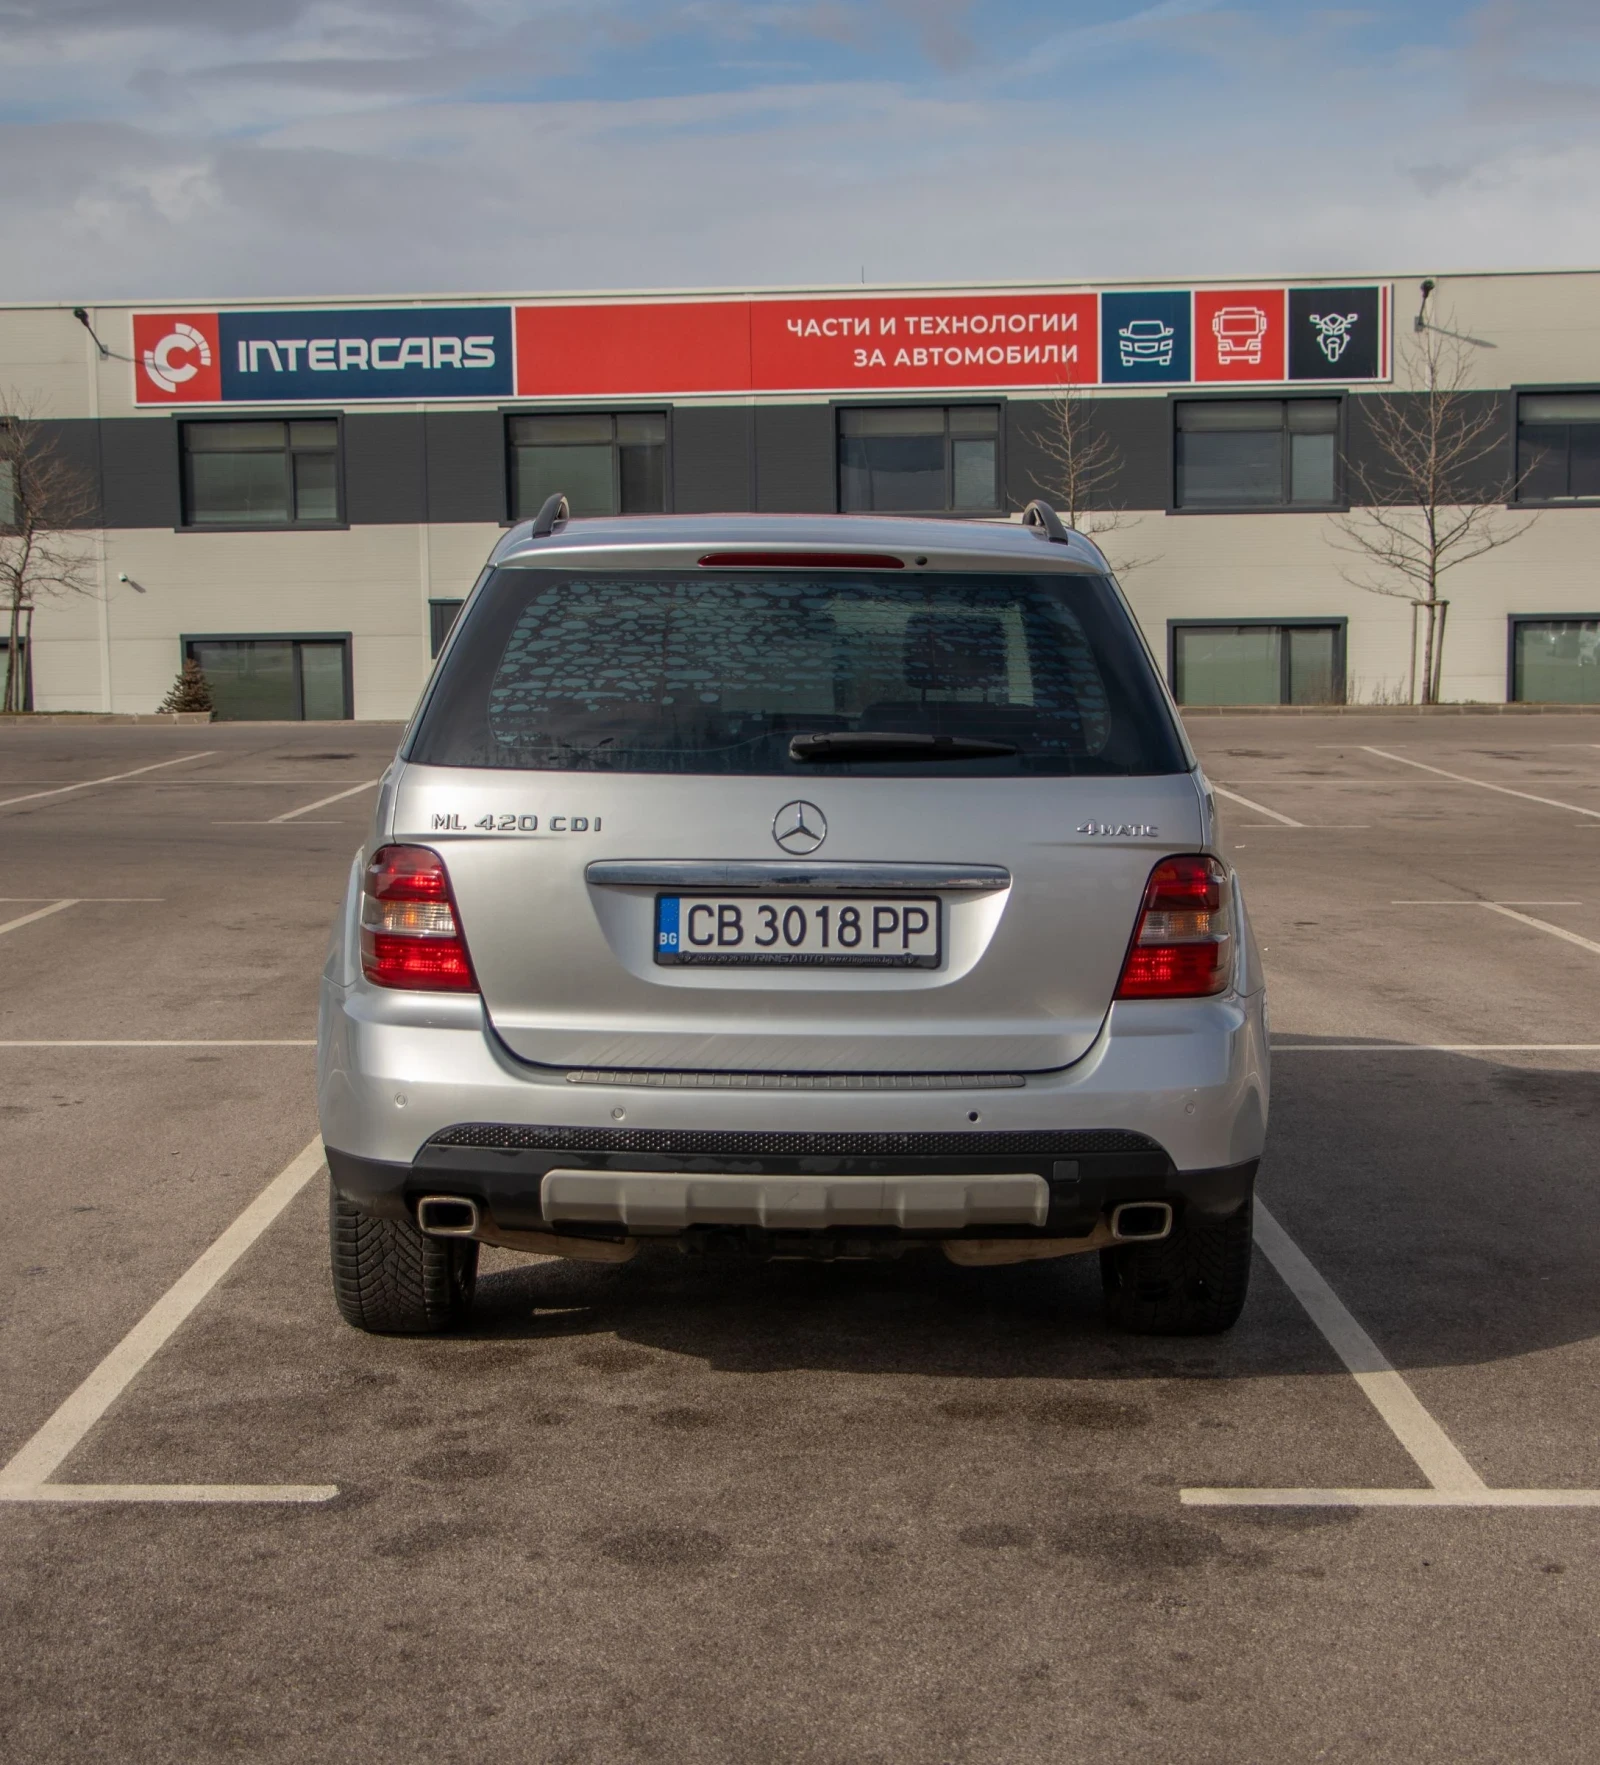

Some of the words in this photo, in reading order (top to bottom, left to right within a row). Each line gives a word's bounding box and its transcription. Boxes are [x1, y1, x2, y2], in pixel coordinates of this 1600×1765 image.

[787, 317, 871, 337] ЧАСТИ
[880, 316, 897, 335] И
[904, 313, 1079, 335] ТЕХНОЛОГИИ
[237, 335, 496, 373] INTERCARS
[853, 348, 886, 368] ЗА
[893, 344, 1079, 367] АВТОМОБИЛИ
[431, 813, 467, 830] ML
[474, 814, 538, 831] 420
[549, 816, 602, 832] CDI
[659, 932, 678, 945] BG
[687, 904, 744, 946] CB
[754, 904, 862, 947] 3018
[872, 906, 930, 949] PP
